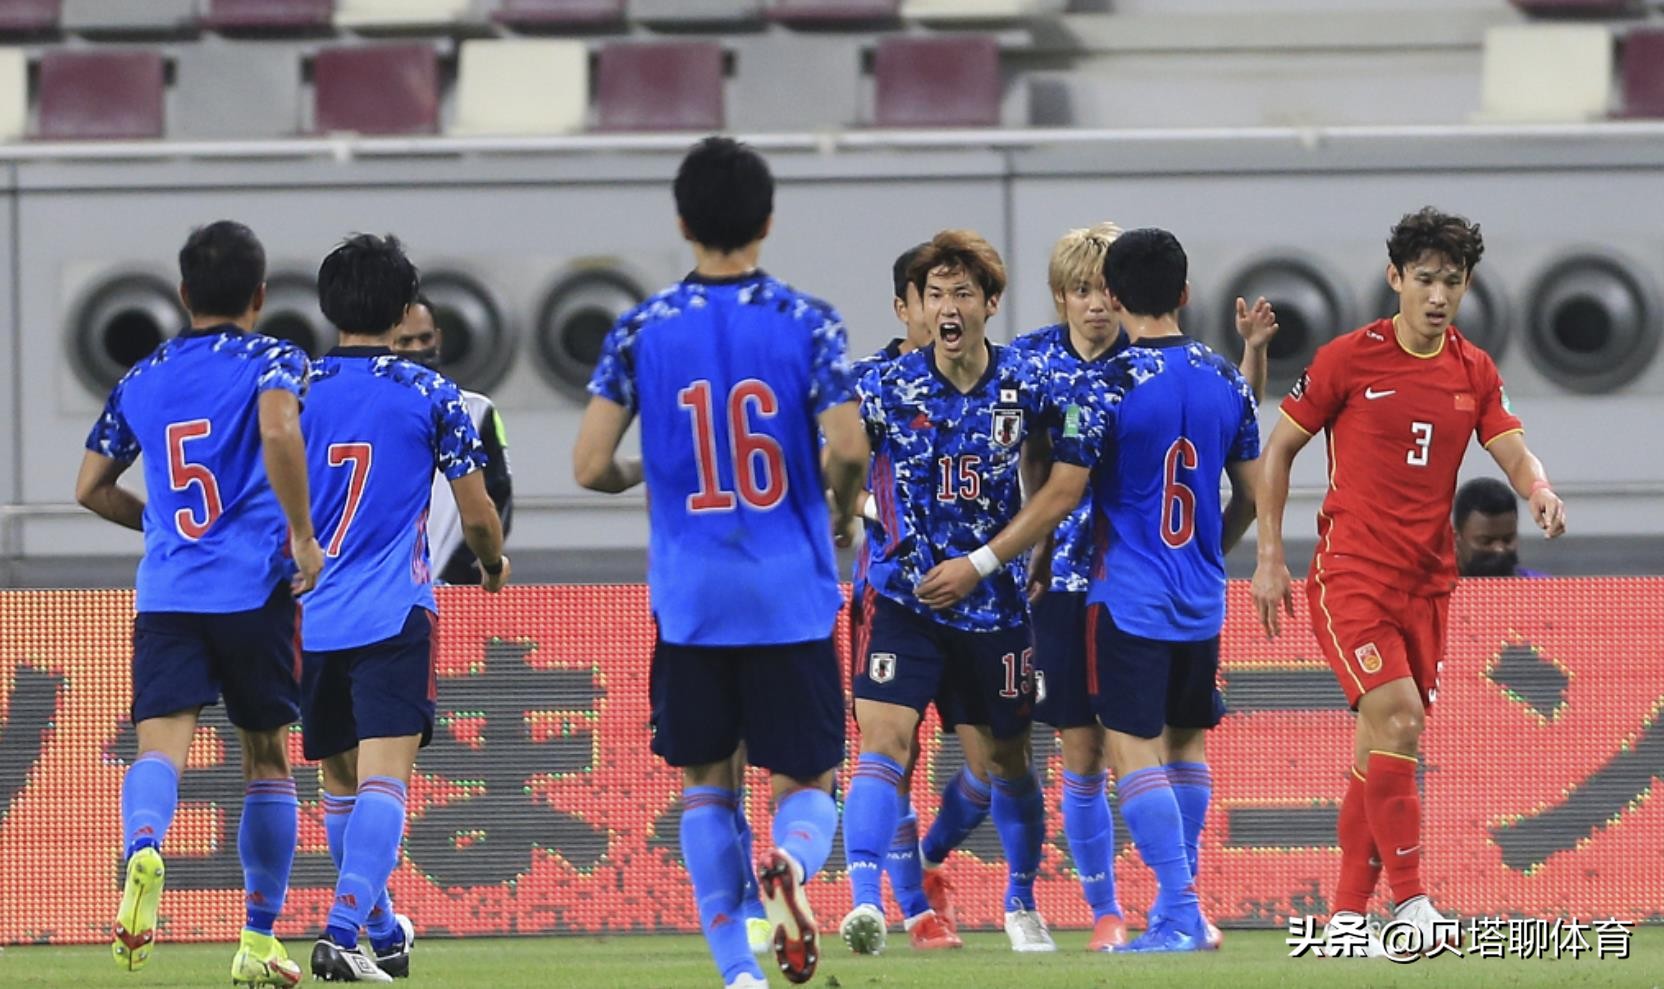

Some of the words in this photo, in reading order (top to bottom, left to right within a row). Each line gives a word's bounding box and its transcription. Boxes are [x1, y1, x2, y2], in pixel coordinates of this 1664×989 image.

[165, 419, 223, 541] 5
[326, 442, 373, 557] 7
[677, 378, 788, 513] 16
[936, 454, 982, 502] 15
[1160, 436, 1198, 549] 6
[1407, 421, 1433, 467] 3
[999, 647, 1032, 697] 15
